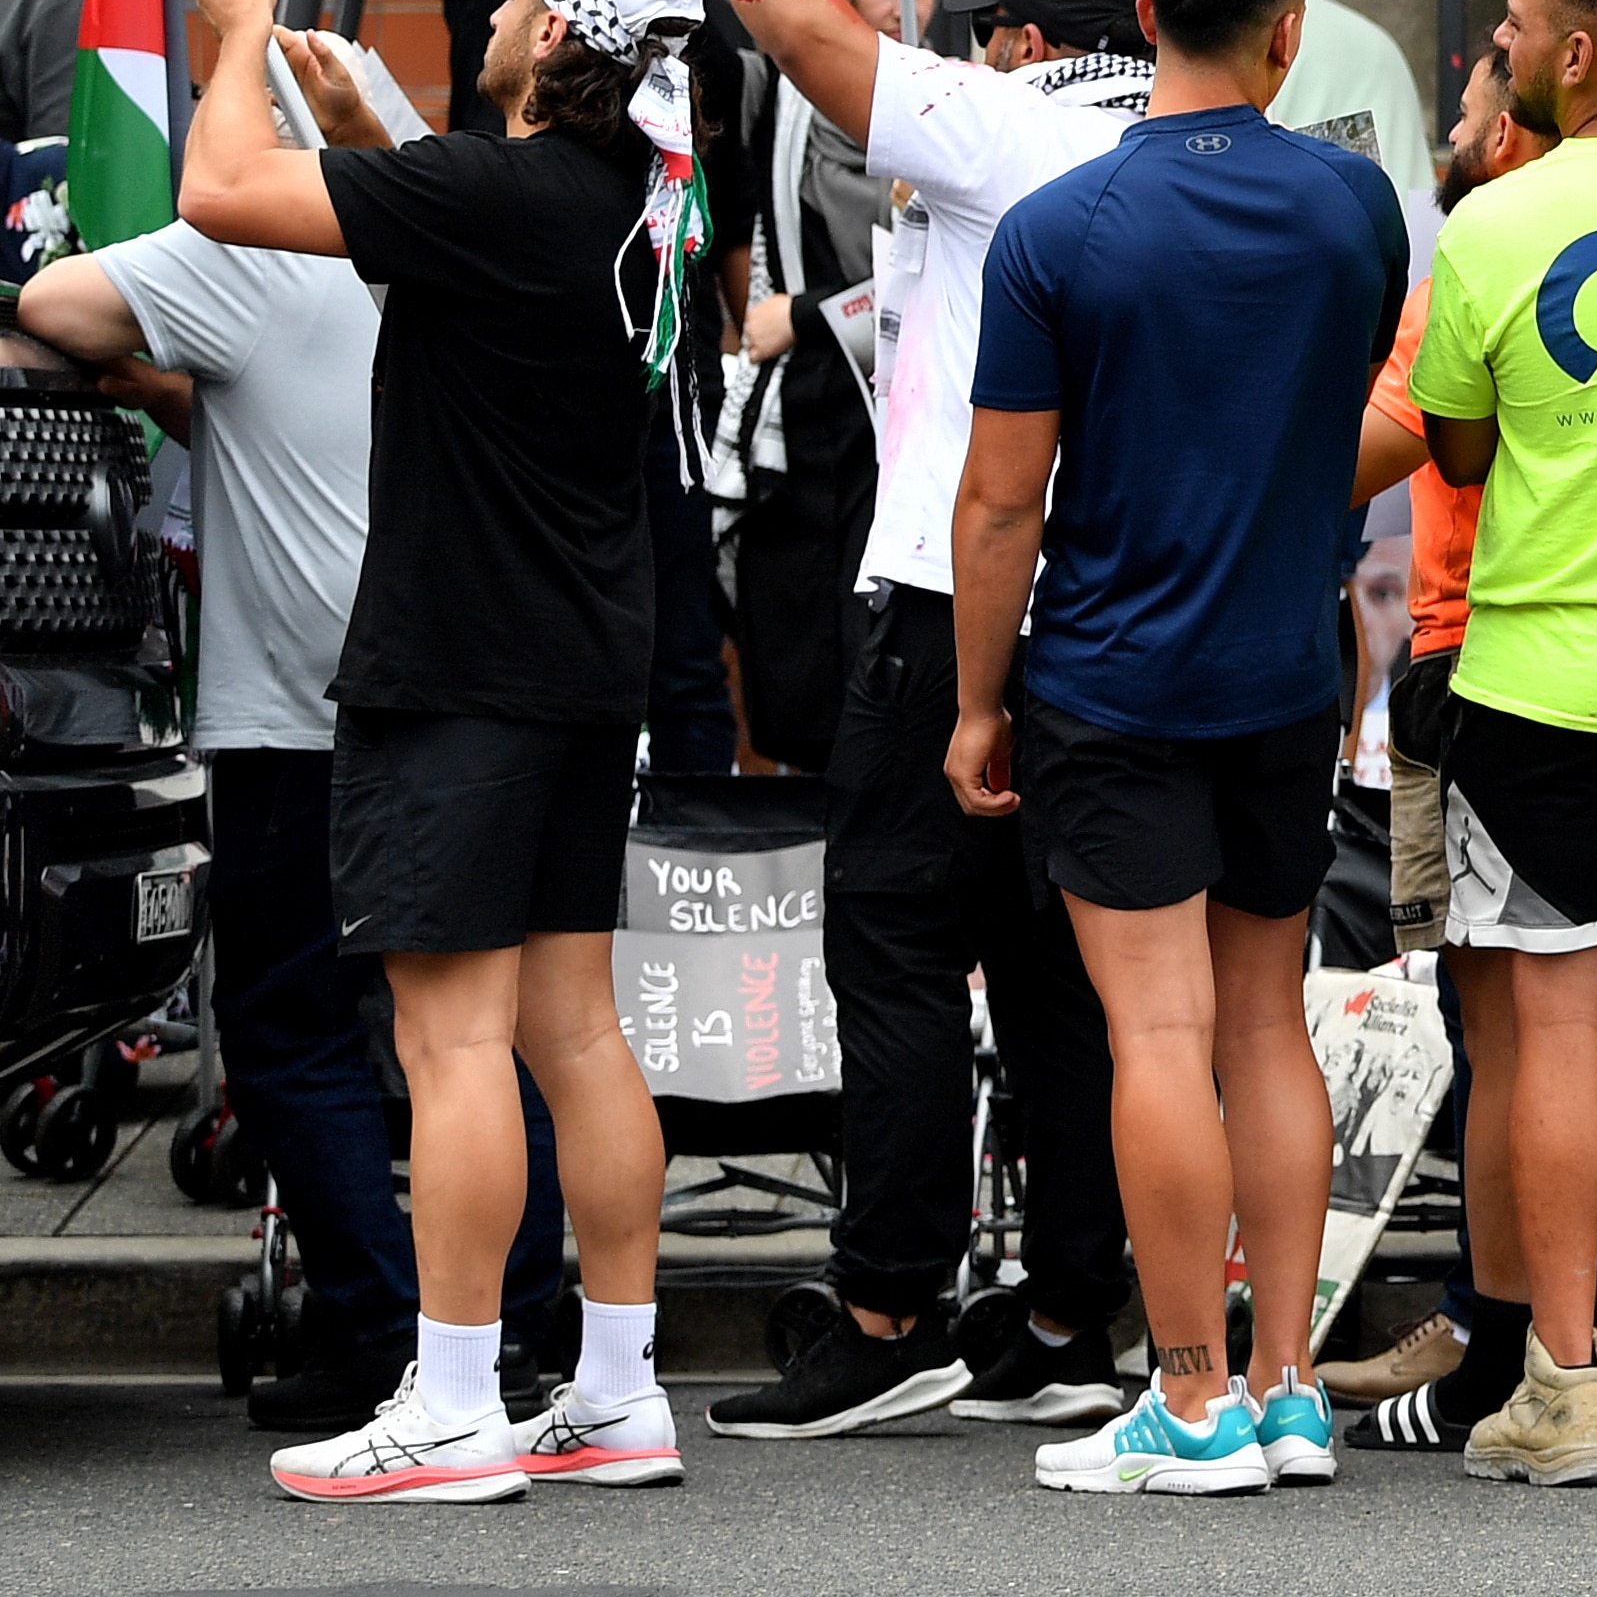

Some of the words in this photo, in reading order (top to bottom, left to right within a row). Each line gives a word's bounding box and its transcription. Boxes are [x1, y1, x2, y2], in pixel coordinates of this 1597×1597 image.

[648, 858, 742, 898] YOUR
[669, 889, 818, 934] SILENCE
[638, 961, 680, 1074] SILENCE
[691, 1009, 733, 1048] IS
[737, 951, 783, 1092] VIOLENCE
